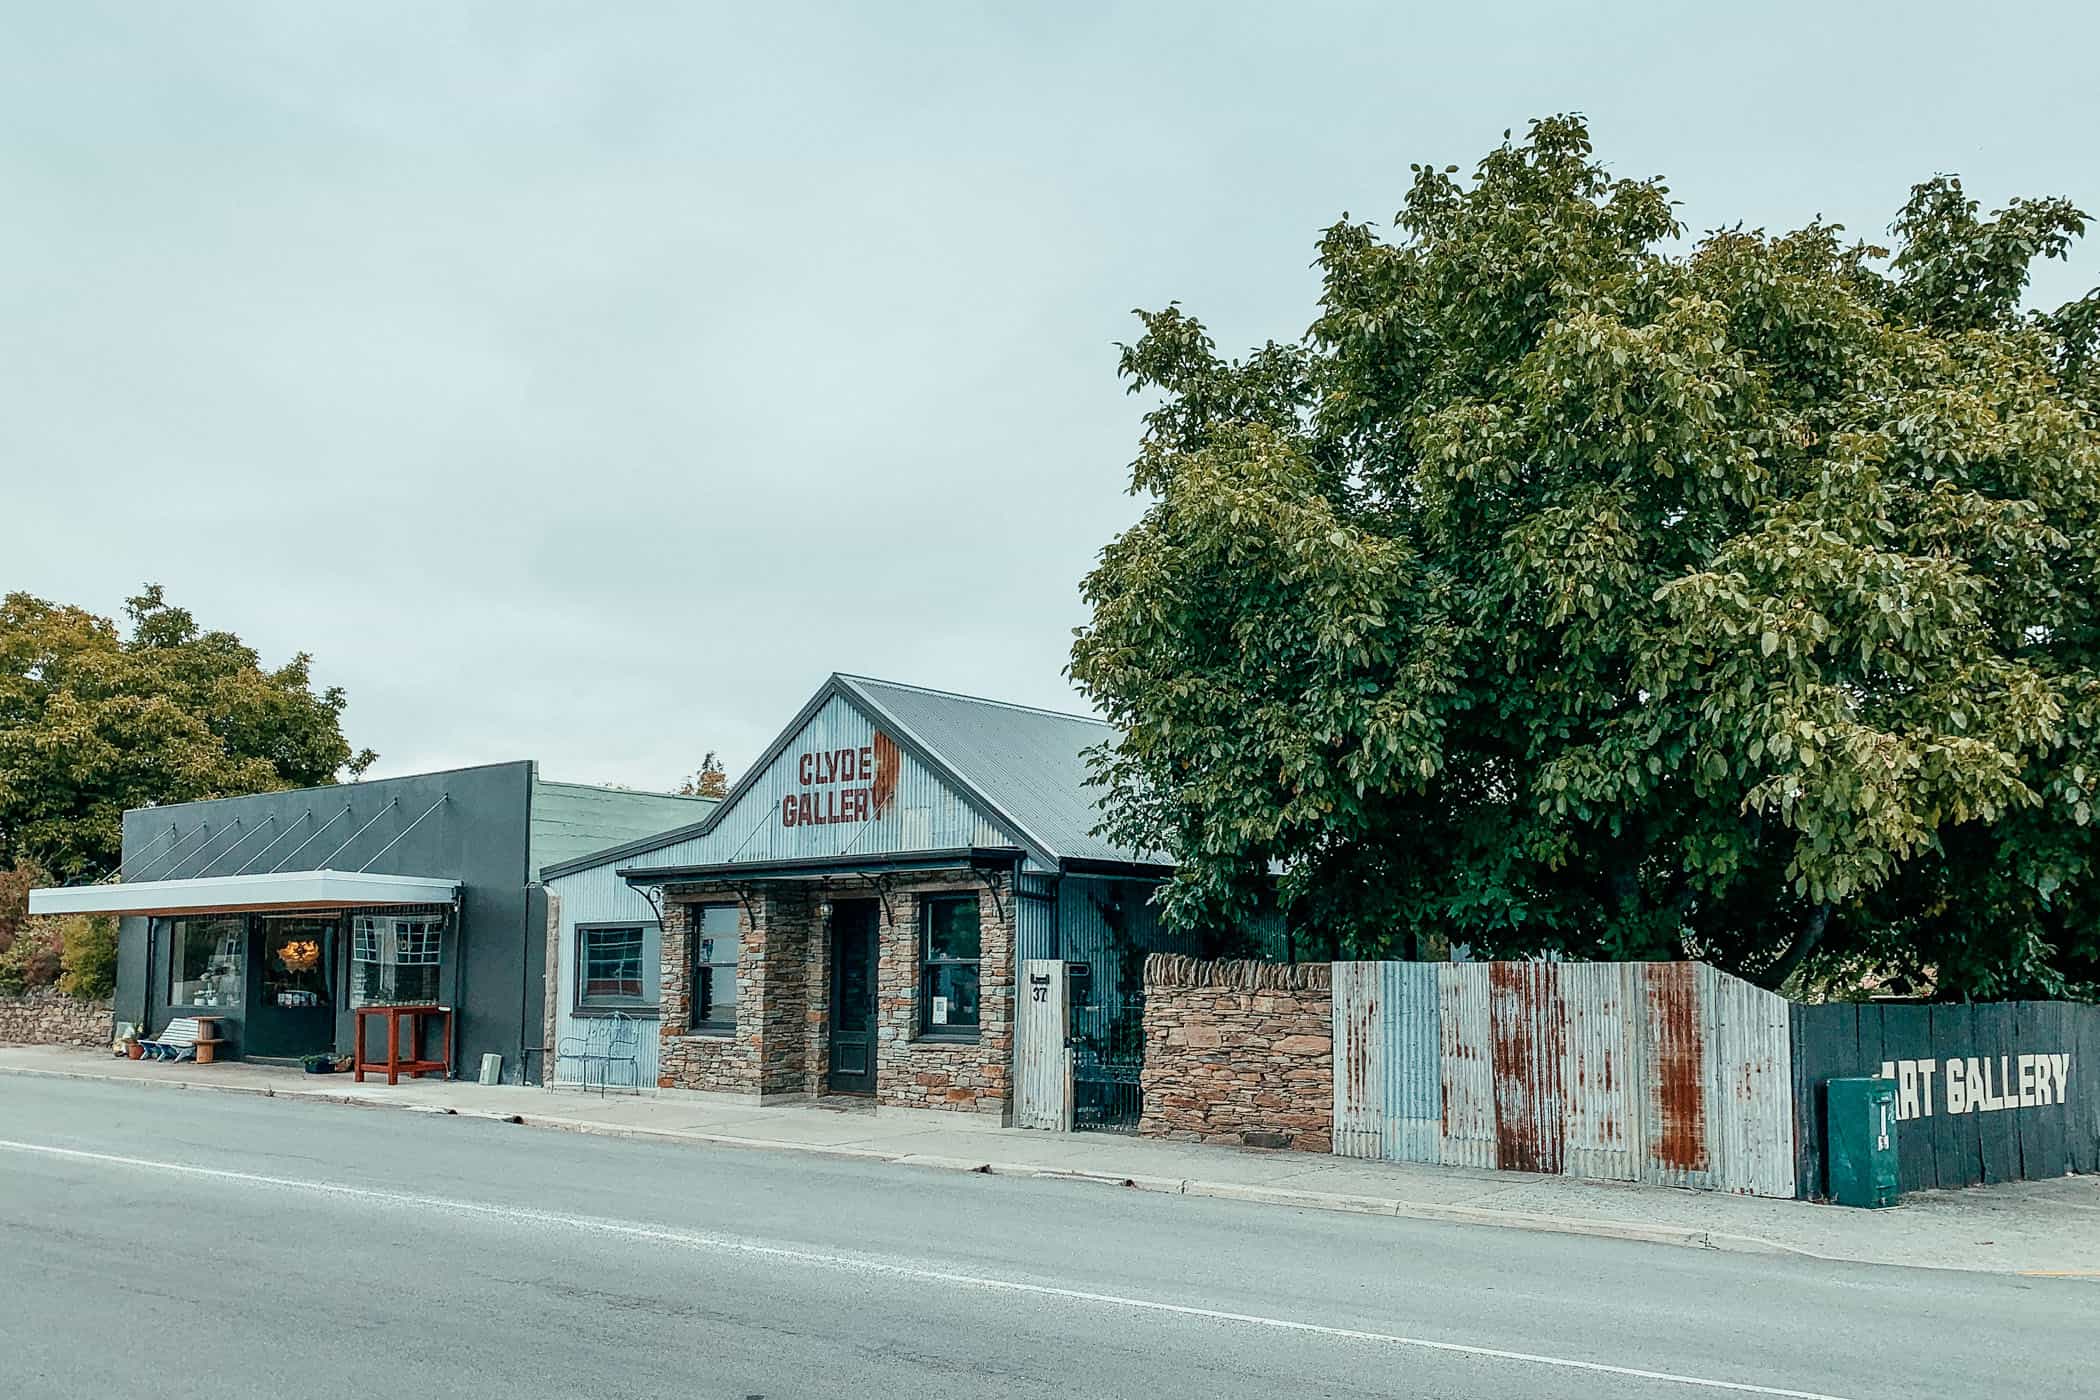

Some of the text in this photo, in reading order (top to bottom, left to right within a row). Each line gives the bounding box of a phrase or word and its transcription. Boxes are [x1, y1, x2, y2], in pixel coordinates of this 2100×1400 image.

[799, 747, 872, 785] CLYDE
[1033, 987, 1048, 1002] 37
[1946, 1053, 2070, 1114] GALLERY
